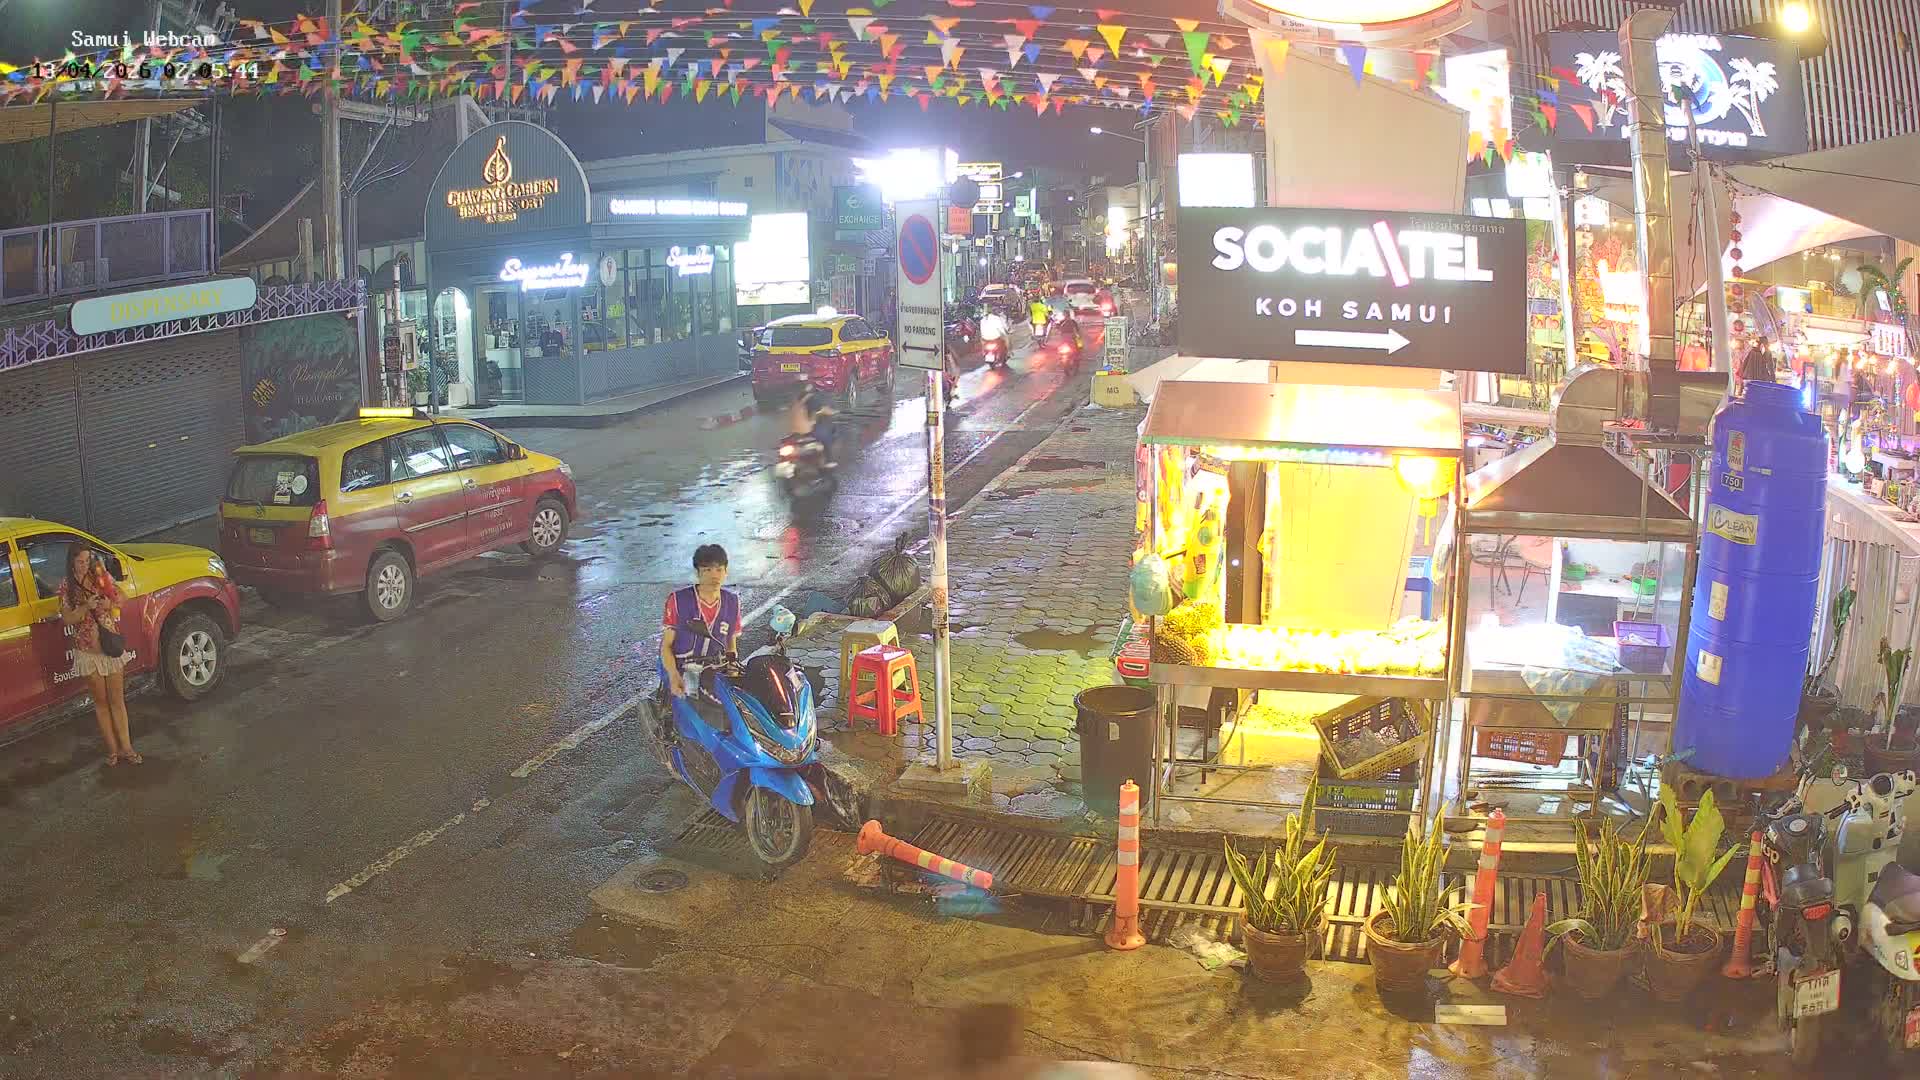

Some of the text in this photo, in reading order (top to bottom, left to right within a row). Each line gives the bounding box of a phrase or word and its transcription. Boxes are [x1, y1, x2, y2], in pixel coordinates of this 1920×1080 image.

[839, 215, 880, 224] EXCHANGE
[110, 288, 223, 323] DISPENSARY
[1255, 297, 1451, 324] KOH SAMUI
[904, 325, 936, 337] NO PARKING
[1106, 387, 1120, 395] MG
[1724, 475, 1740, 487] 750
